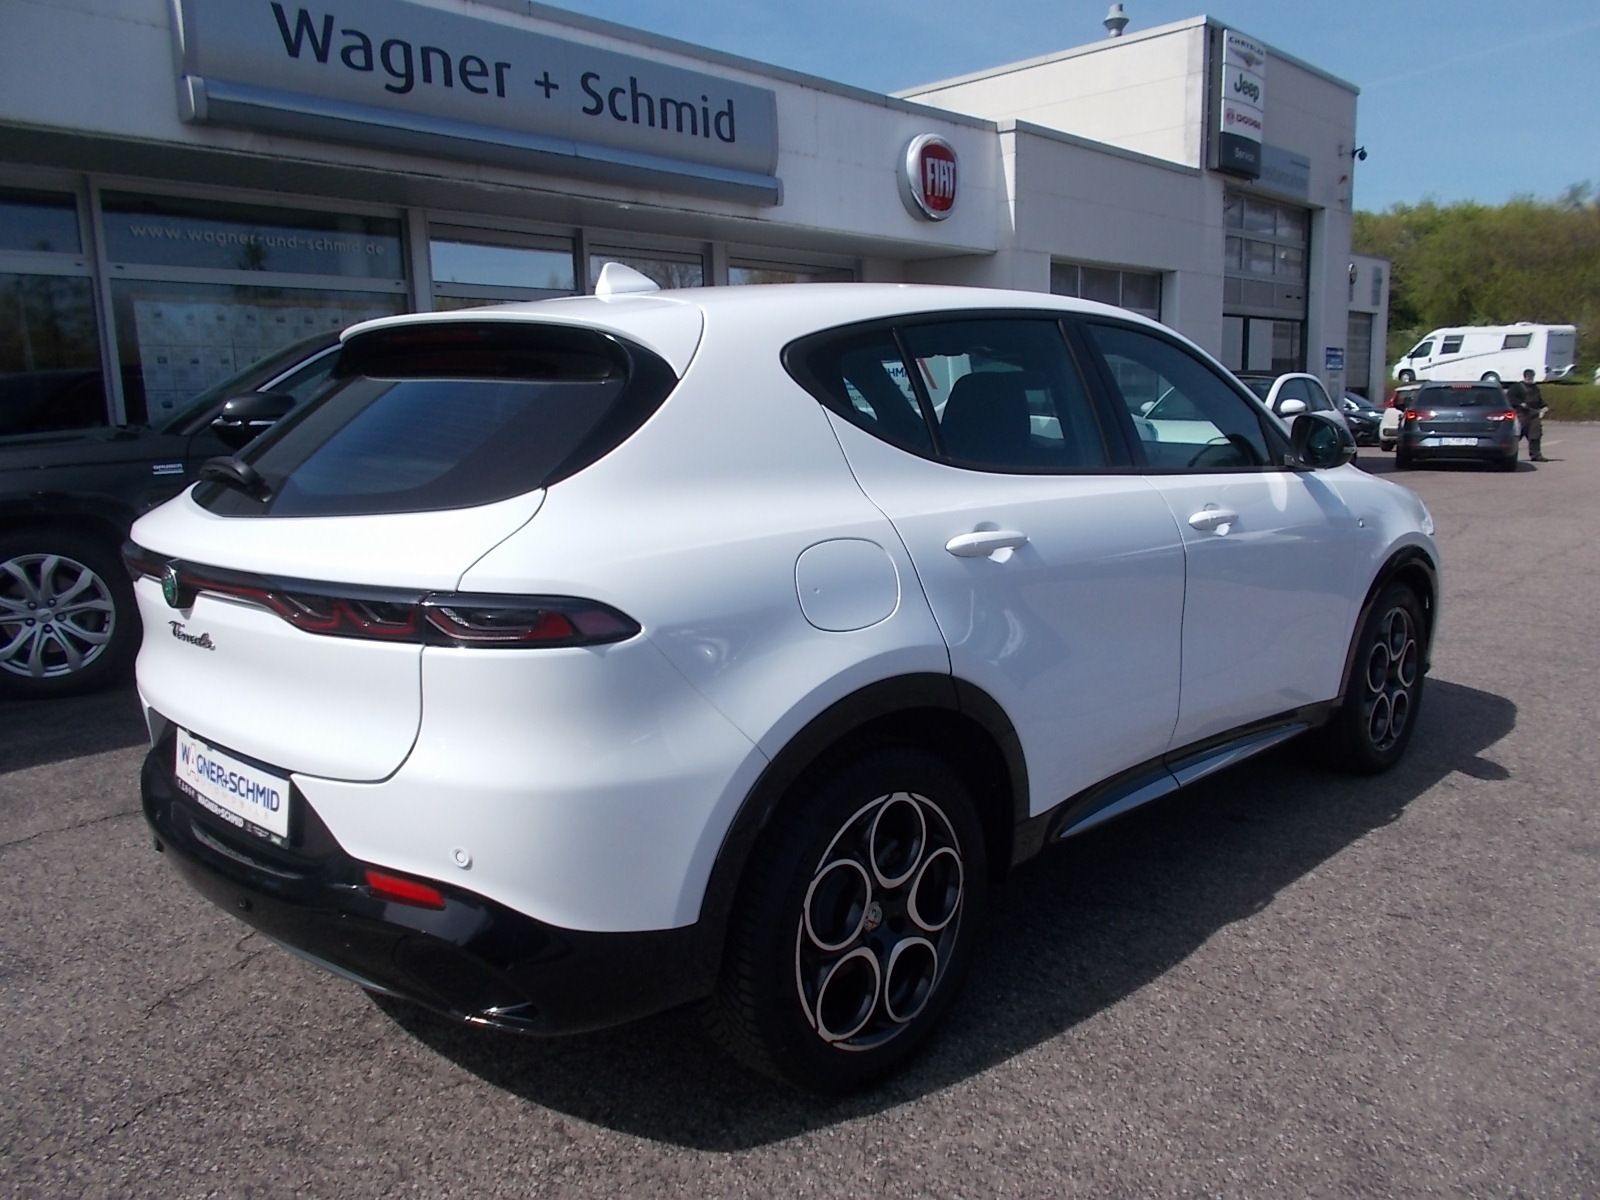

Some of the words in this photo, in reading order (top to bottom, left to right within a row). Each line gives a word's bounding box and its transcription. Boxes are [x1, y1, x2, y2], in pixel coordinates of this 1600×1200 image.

[270, 2, 511, 98] Wagner
[534, 71, 560, 99] +
[580, 71, 737, 144] Schmid
[1233, 72, 1260, 103] Jeep
[1235, 113, 1262, 130] DODGE
[926, 156, 956, 200] FIAT
[130, 224, 385, 256] www.wagner-und-schmid.de
